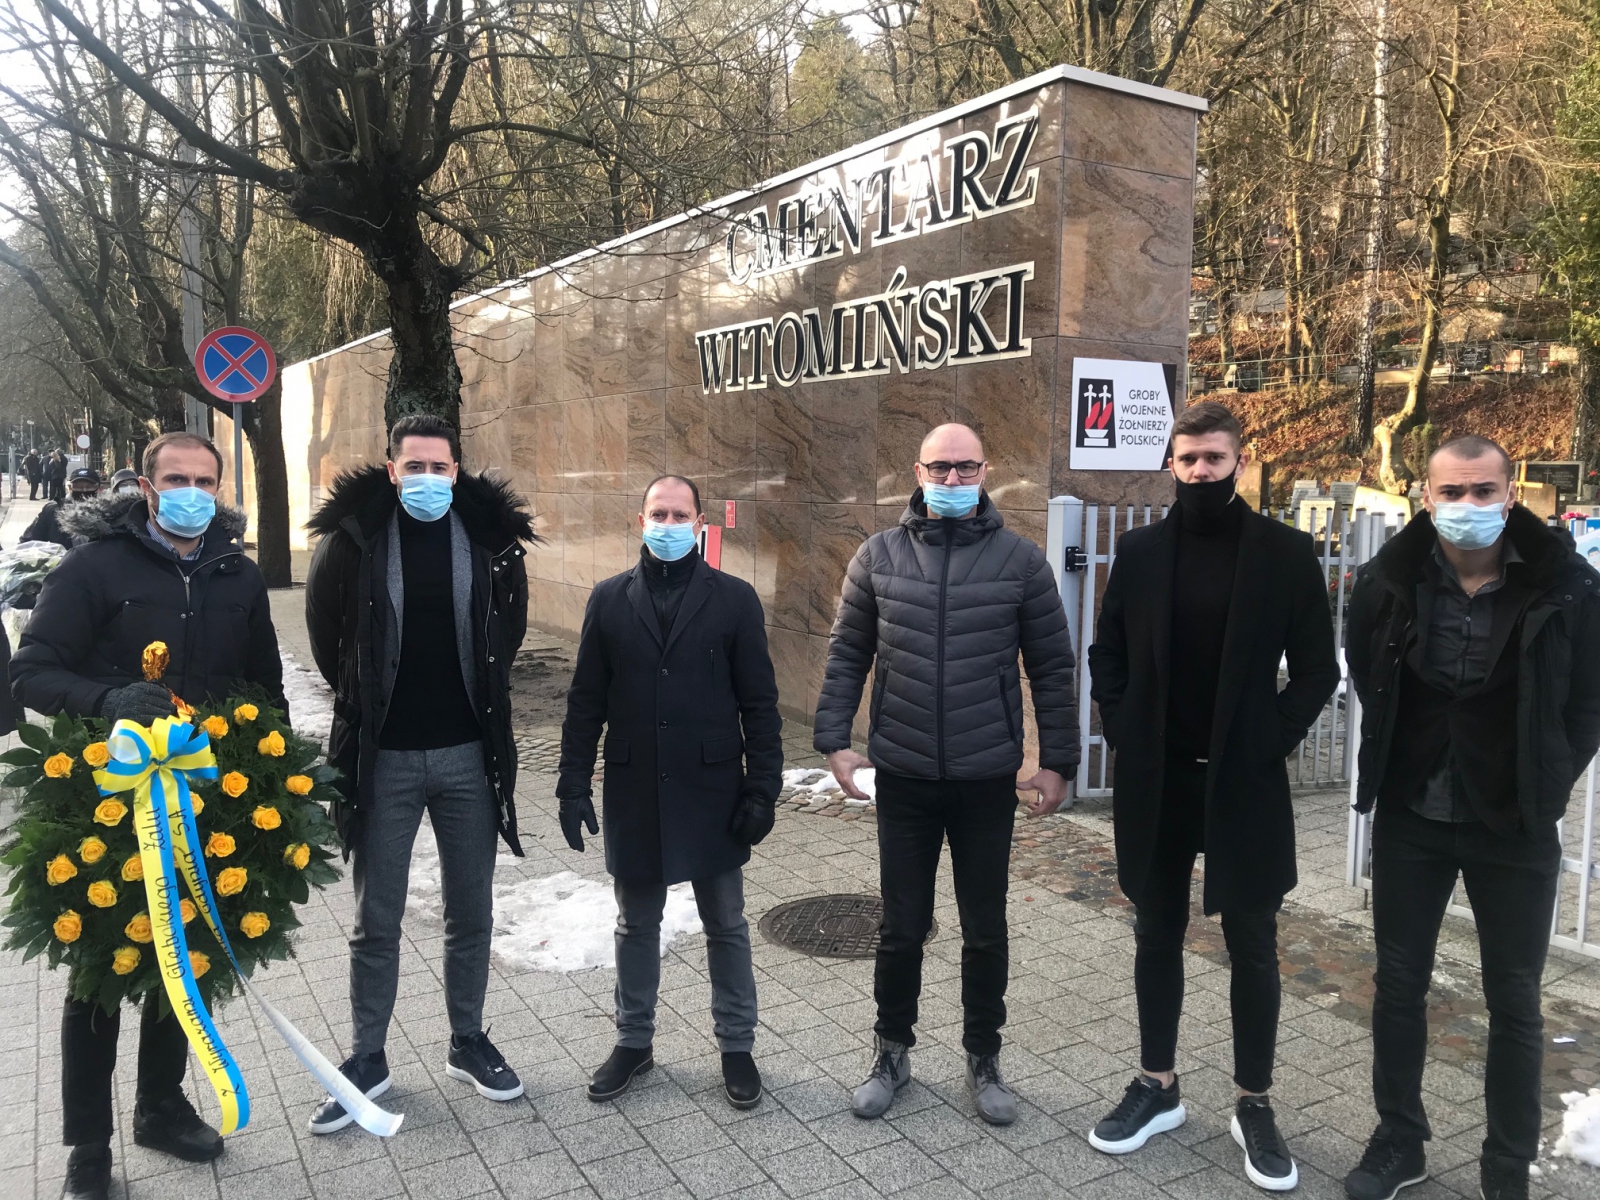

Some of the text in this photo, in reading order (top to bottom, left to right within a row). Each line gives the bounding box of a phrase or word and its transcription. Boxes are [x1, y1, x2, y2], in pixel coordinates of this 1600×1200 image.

[726, 107, 1040, 285] CMENTARZ
[695, 261, 1035, 395] WITOMIŃSKI
[1128, 389, 1161, 401] GROBY
[1120, 404, 1167, 416] WOJENNE
[1118, 416, 1168, 431] ŻOŁNIERZY
[1120, 434, 1165, 446] POLSKICH
